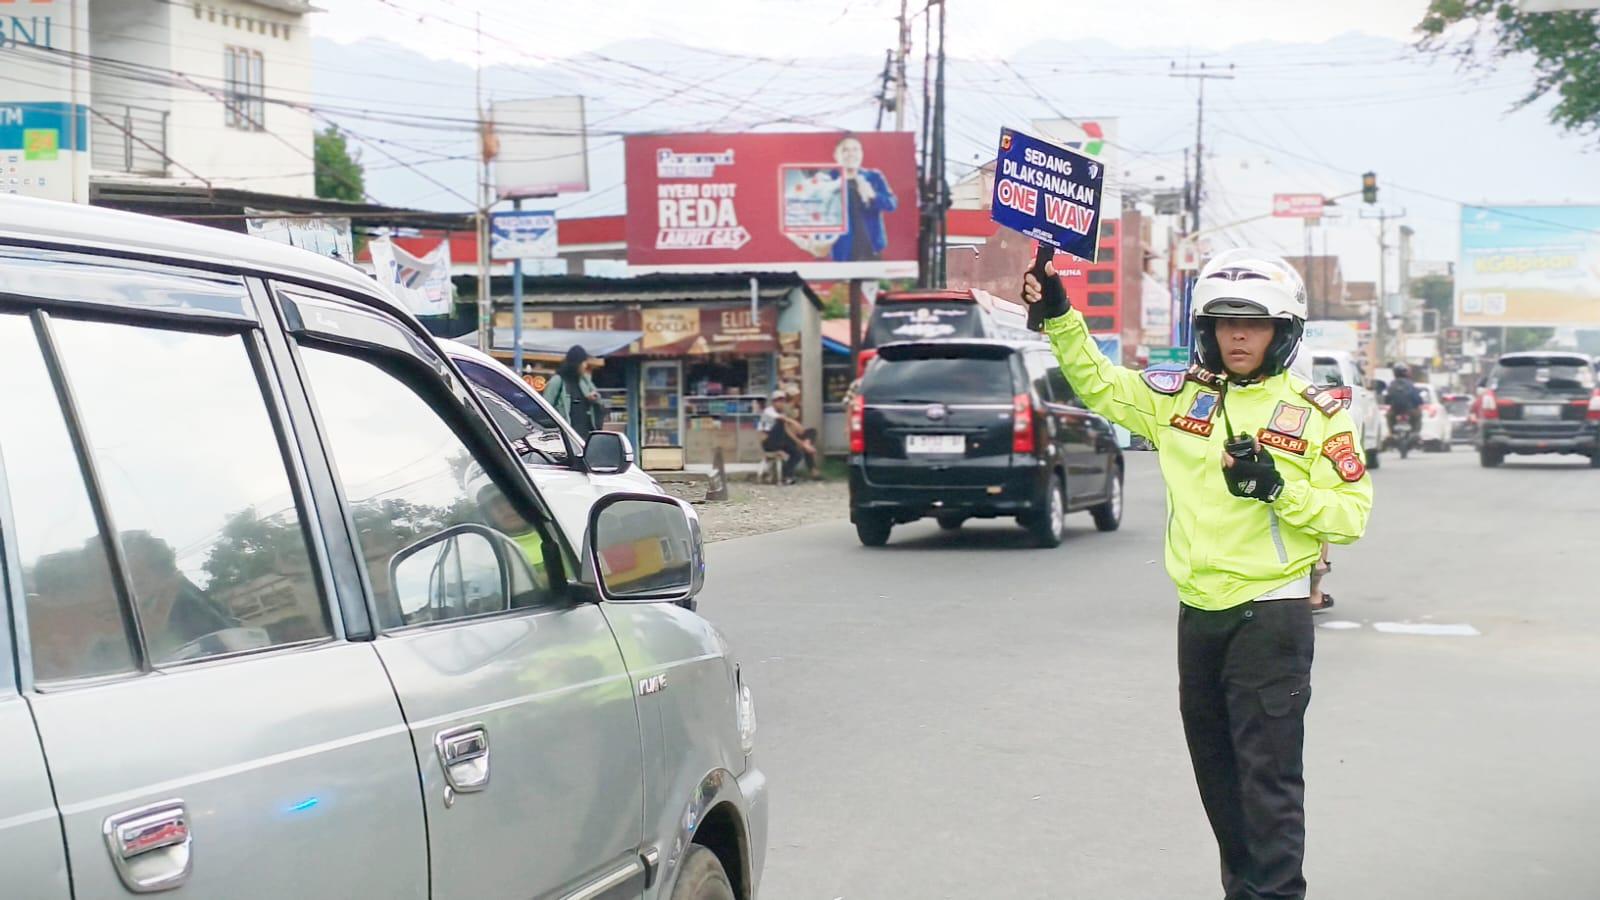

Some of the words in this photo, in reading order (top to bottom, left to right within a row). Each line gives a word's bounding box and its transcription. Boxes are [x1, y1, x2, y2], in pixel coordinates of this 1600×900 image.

[1024, 147, 1072, 175] SEDANG
[658, 184, 699, 198] NYERI
[701, 184, 737, 198] OTOT
[1003, 158, 1094, 205] DILAKSANAKAN
[658, 199, 738, 228] REDA
[998, 179, 1038, 216] ONE
[1044, 193, 1095, 236] WAY
[574, 315, 615, 331] ELITE
[1173, 417, 1211, 434] RIKI
[1262, 431, 1303, 451] POLRI
